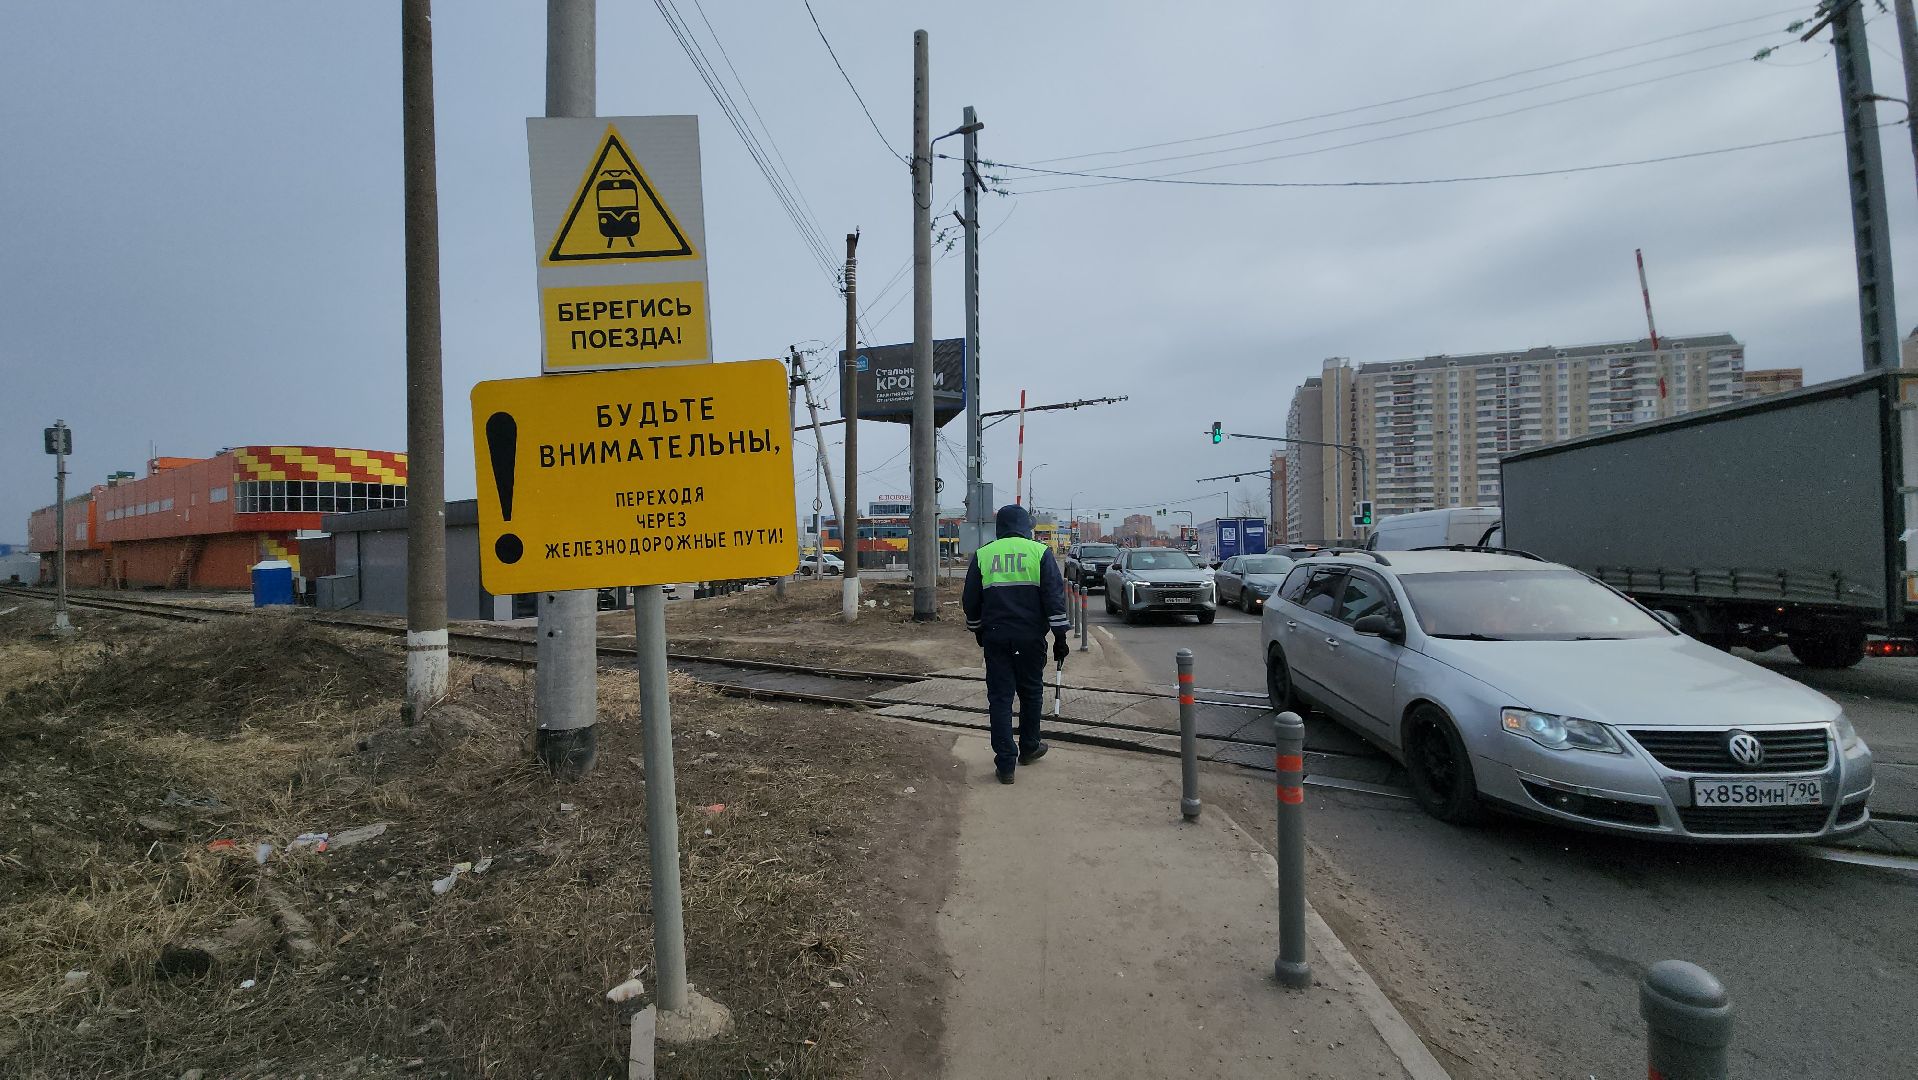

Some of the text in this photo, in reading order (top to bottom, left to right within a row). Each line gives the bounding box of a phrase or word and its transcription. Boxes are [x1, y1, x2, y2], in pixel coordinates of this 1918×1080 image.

[557, 298, 692, 322] БЕРЕГИСЬ
[571, 326, 682, 350] ПОЕЗДА!
[875, 367, 915, 377] Стальны
[876, 372, 944, 391] КРОИ
[596, 396, 715, 429] БУДЬТЕ
[539, 428, 781, 468] ВНИМАТЕЛЬНЫ,
[615, 486, 704, 508] ПЕРЕХОДЯ
[636, 511, 687, 529] ЧЕРЕЗ
[544, 527, 783, 560] ЖЕЛЕЗНОДОРОЖНЫЕ ПУТИ!
[990, 552, 1028, 575] ДПС
